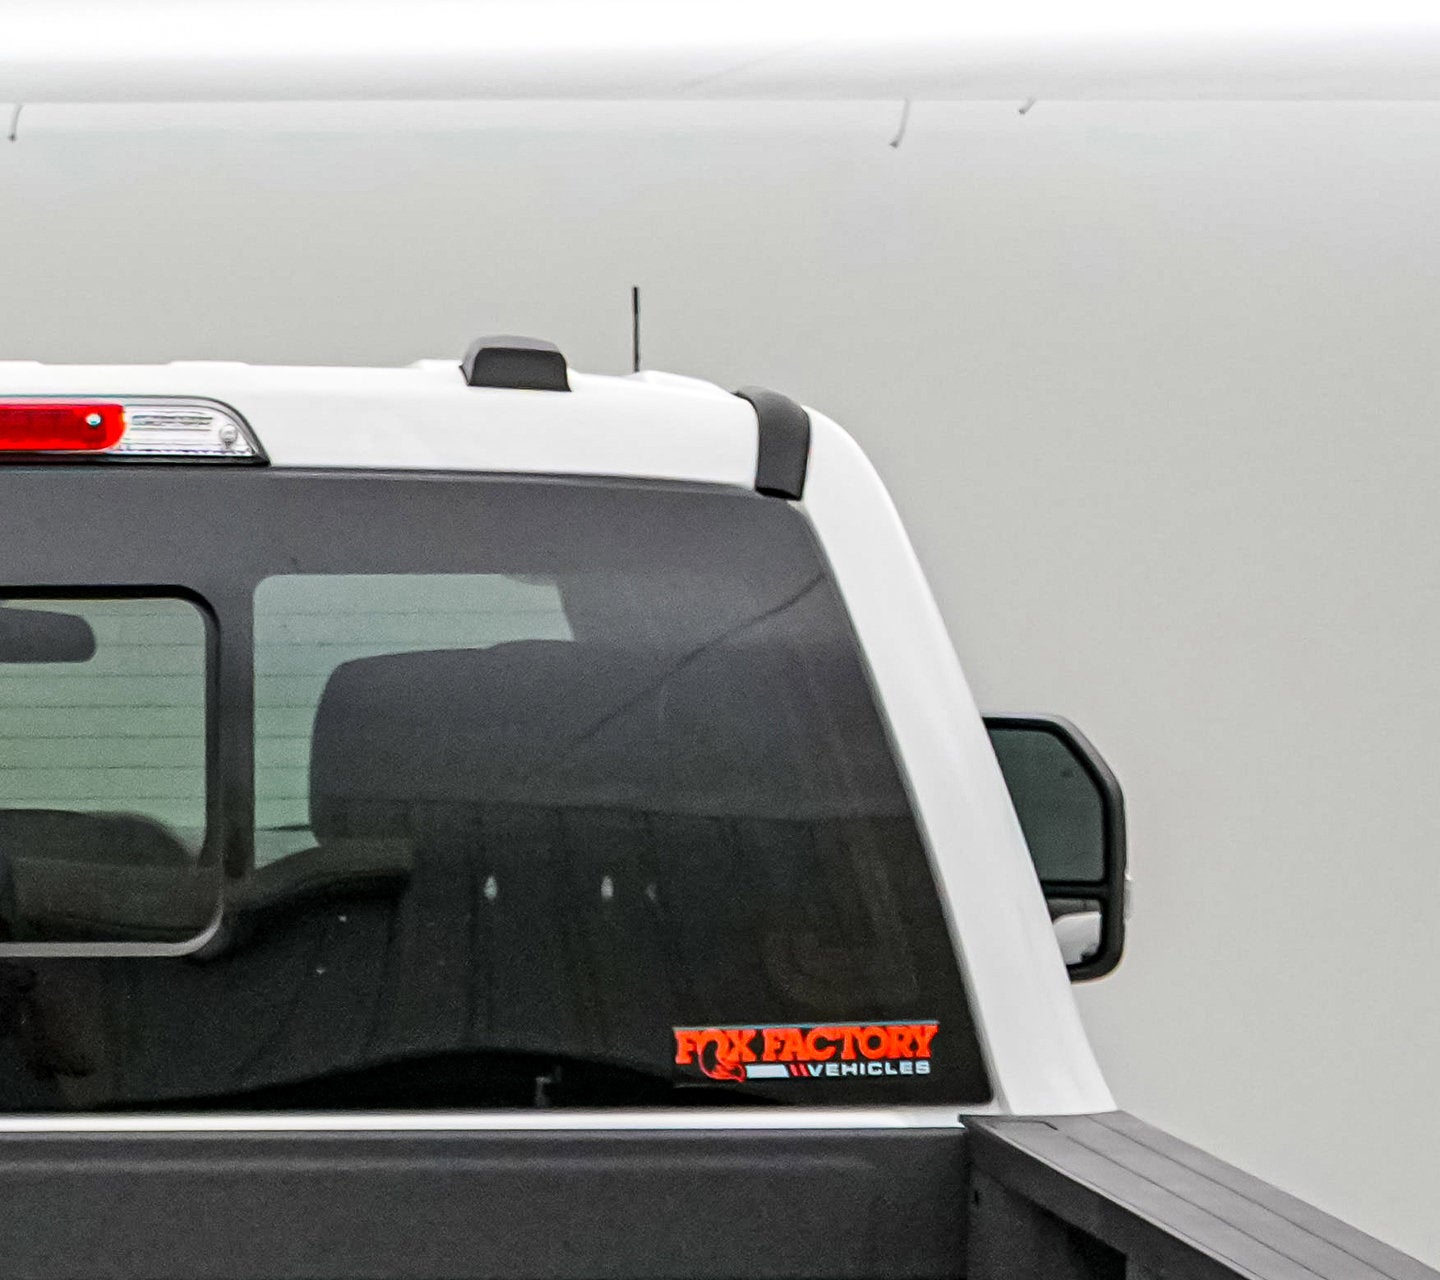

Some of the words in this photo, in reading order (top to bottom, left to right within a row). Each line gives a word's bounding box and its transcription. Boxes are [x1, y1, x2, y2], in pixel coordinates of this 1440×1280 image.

[675, 1028, 757, 1081] FOX
[762, 1024, 940, 1062] FACTORY
[808, 1060, 932, 1078] VEHICLES
